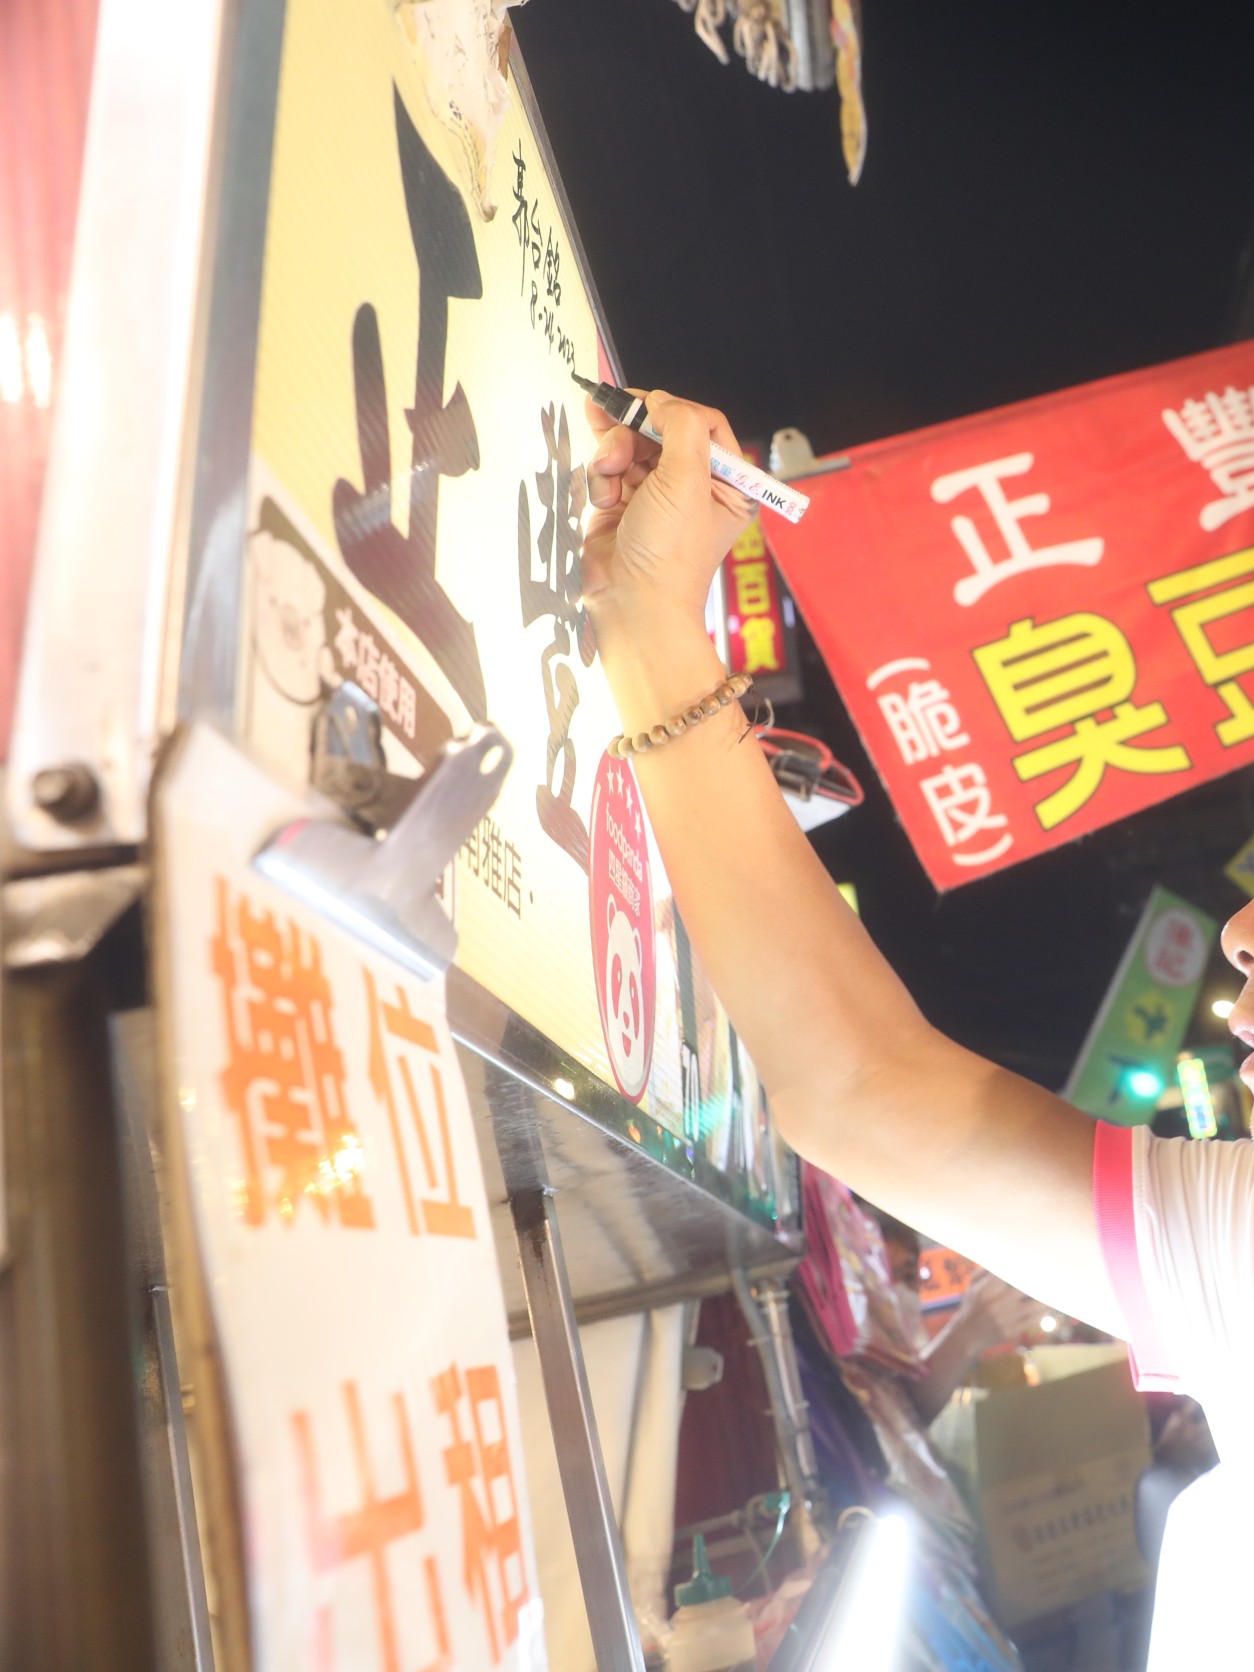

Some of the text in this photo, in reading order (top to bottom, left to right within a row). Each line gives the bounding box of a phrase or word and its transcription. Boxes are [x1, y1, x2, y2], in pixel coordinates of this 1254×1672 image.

[761, 489, 787, 510] INK
[605, 801, 643, 883] foodpanda
[866, 656, 1013, 867] (脆皮)
[212, 872, 478, 1241] 攤位
[288, 1360, 533, 1672] 出租
